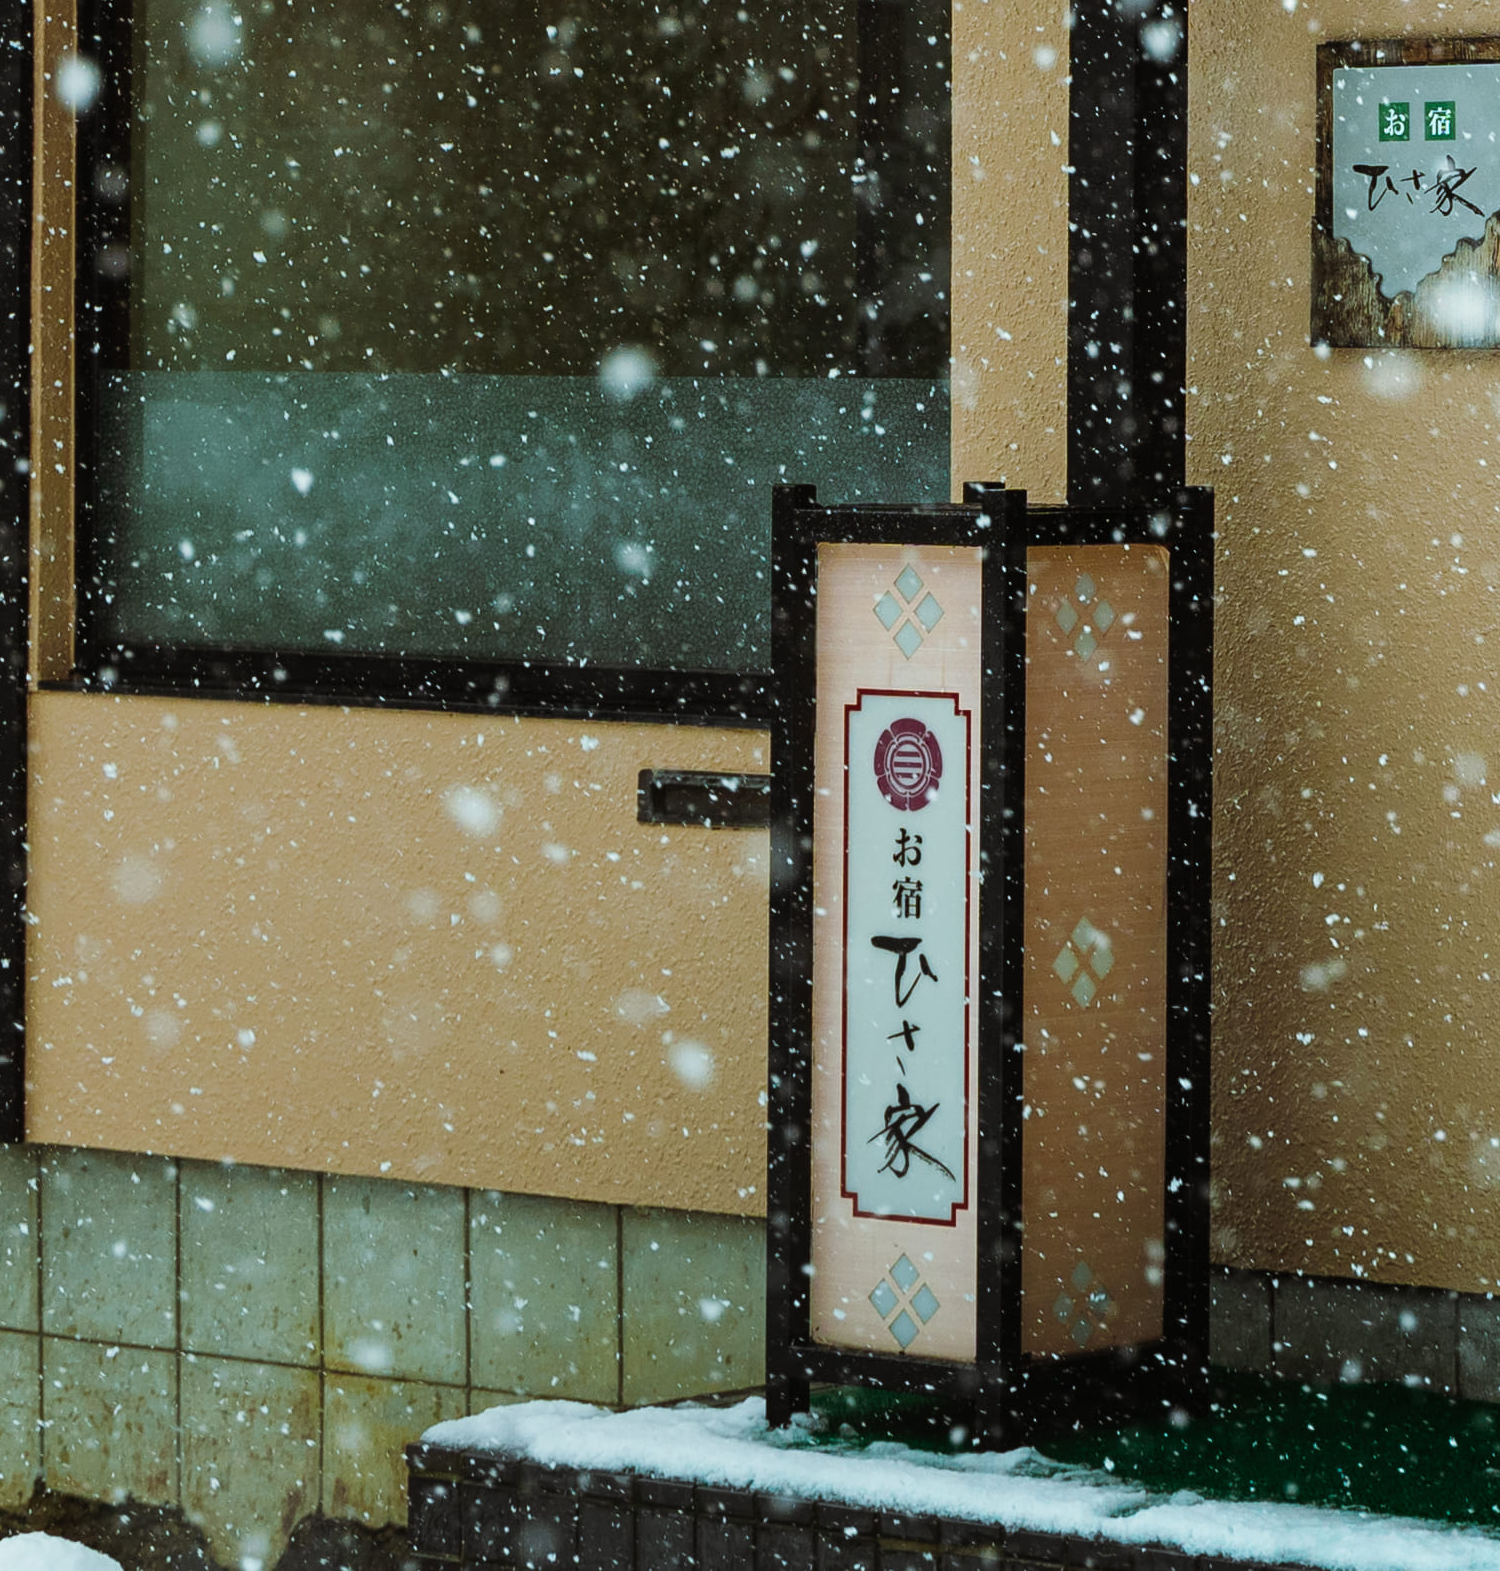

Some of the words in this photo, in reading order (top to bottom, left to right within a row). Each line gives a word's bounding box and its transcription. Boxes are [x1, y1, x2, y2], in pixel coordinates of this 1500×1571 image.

[1384, 107, 1451, 136] お宿
[1352, 155, 1485, 217] ひさ家
